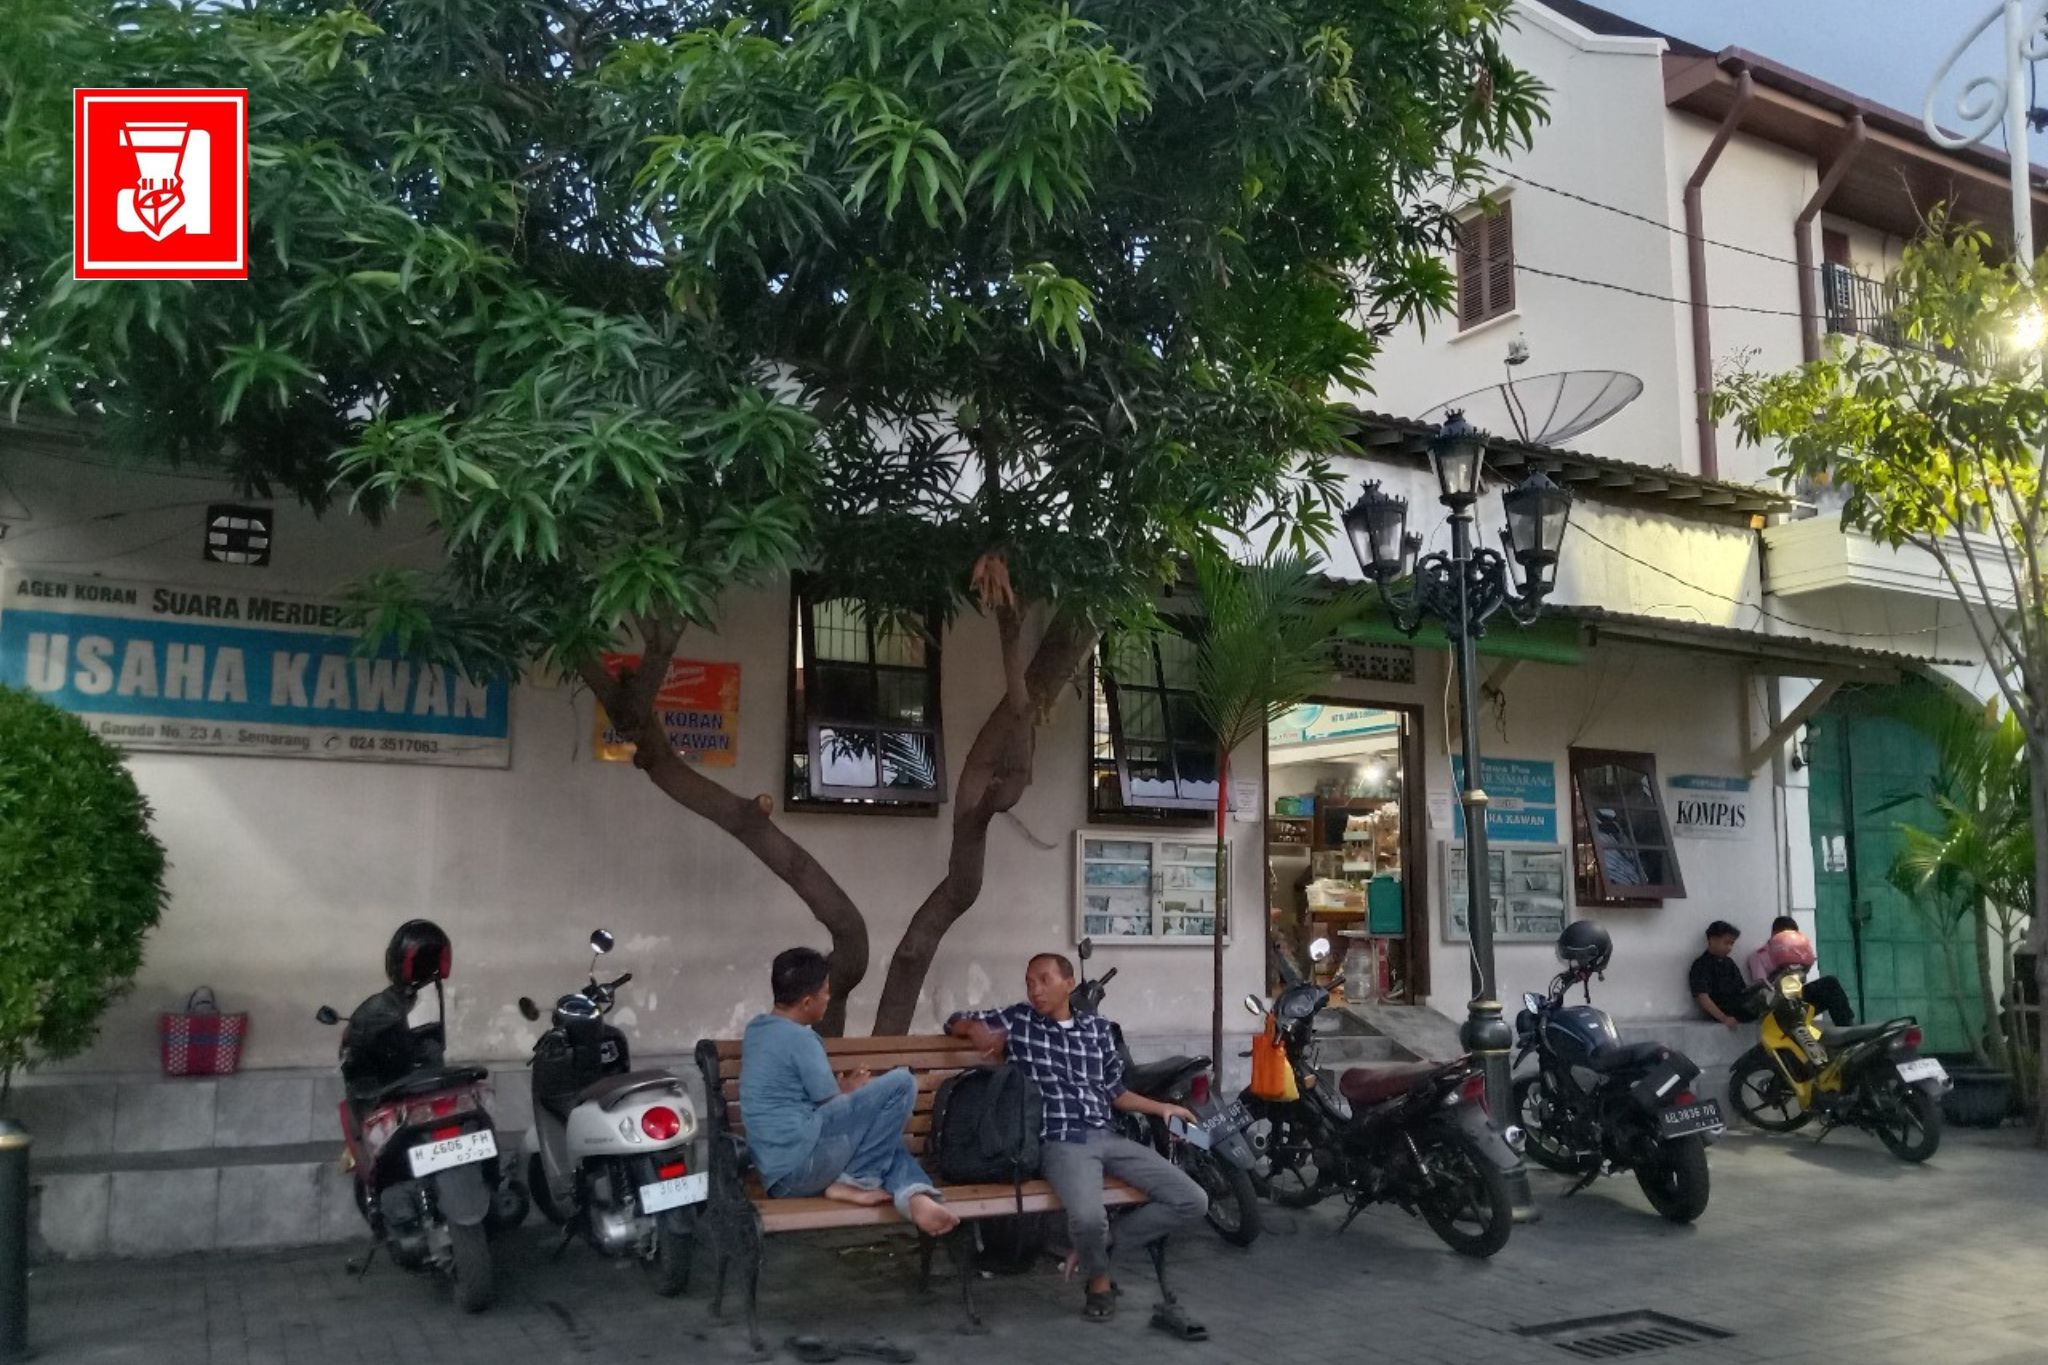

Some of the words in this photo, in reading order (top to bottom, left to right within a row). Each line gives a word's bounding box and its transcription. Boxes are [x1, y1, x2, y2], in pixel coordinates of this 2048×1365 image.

[17, 579, 68, 599] AGEN
[75, 584, 137, 605] KORAN
[152, 588, 240, 620] SUARA
[247, 597, 367, 629] MERDE
[26, 632, 248, 703] USAHA
[270, 650, 488, 720] KAWAN
[664, 711, 723, 730] KORAN
[101, 721, 155, 738] Garuda
[211, 727, 223, 741] A
[237, 729, 311, 750] Semarang
[349, 735, 375, 750] 024
[380, 737, 439, 755] 3517063
[669, 732, 731, 751] KAWAN
[1506, 814, 1546, 827] KAWAN
[1675, 800, 1746, 829] KOMPAS
